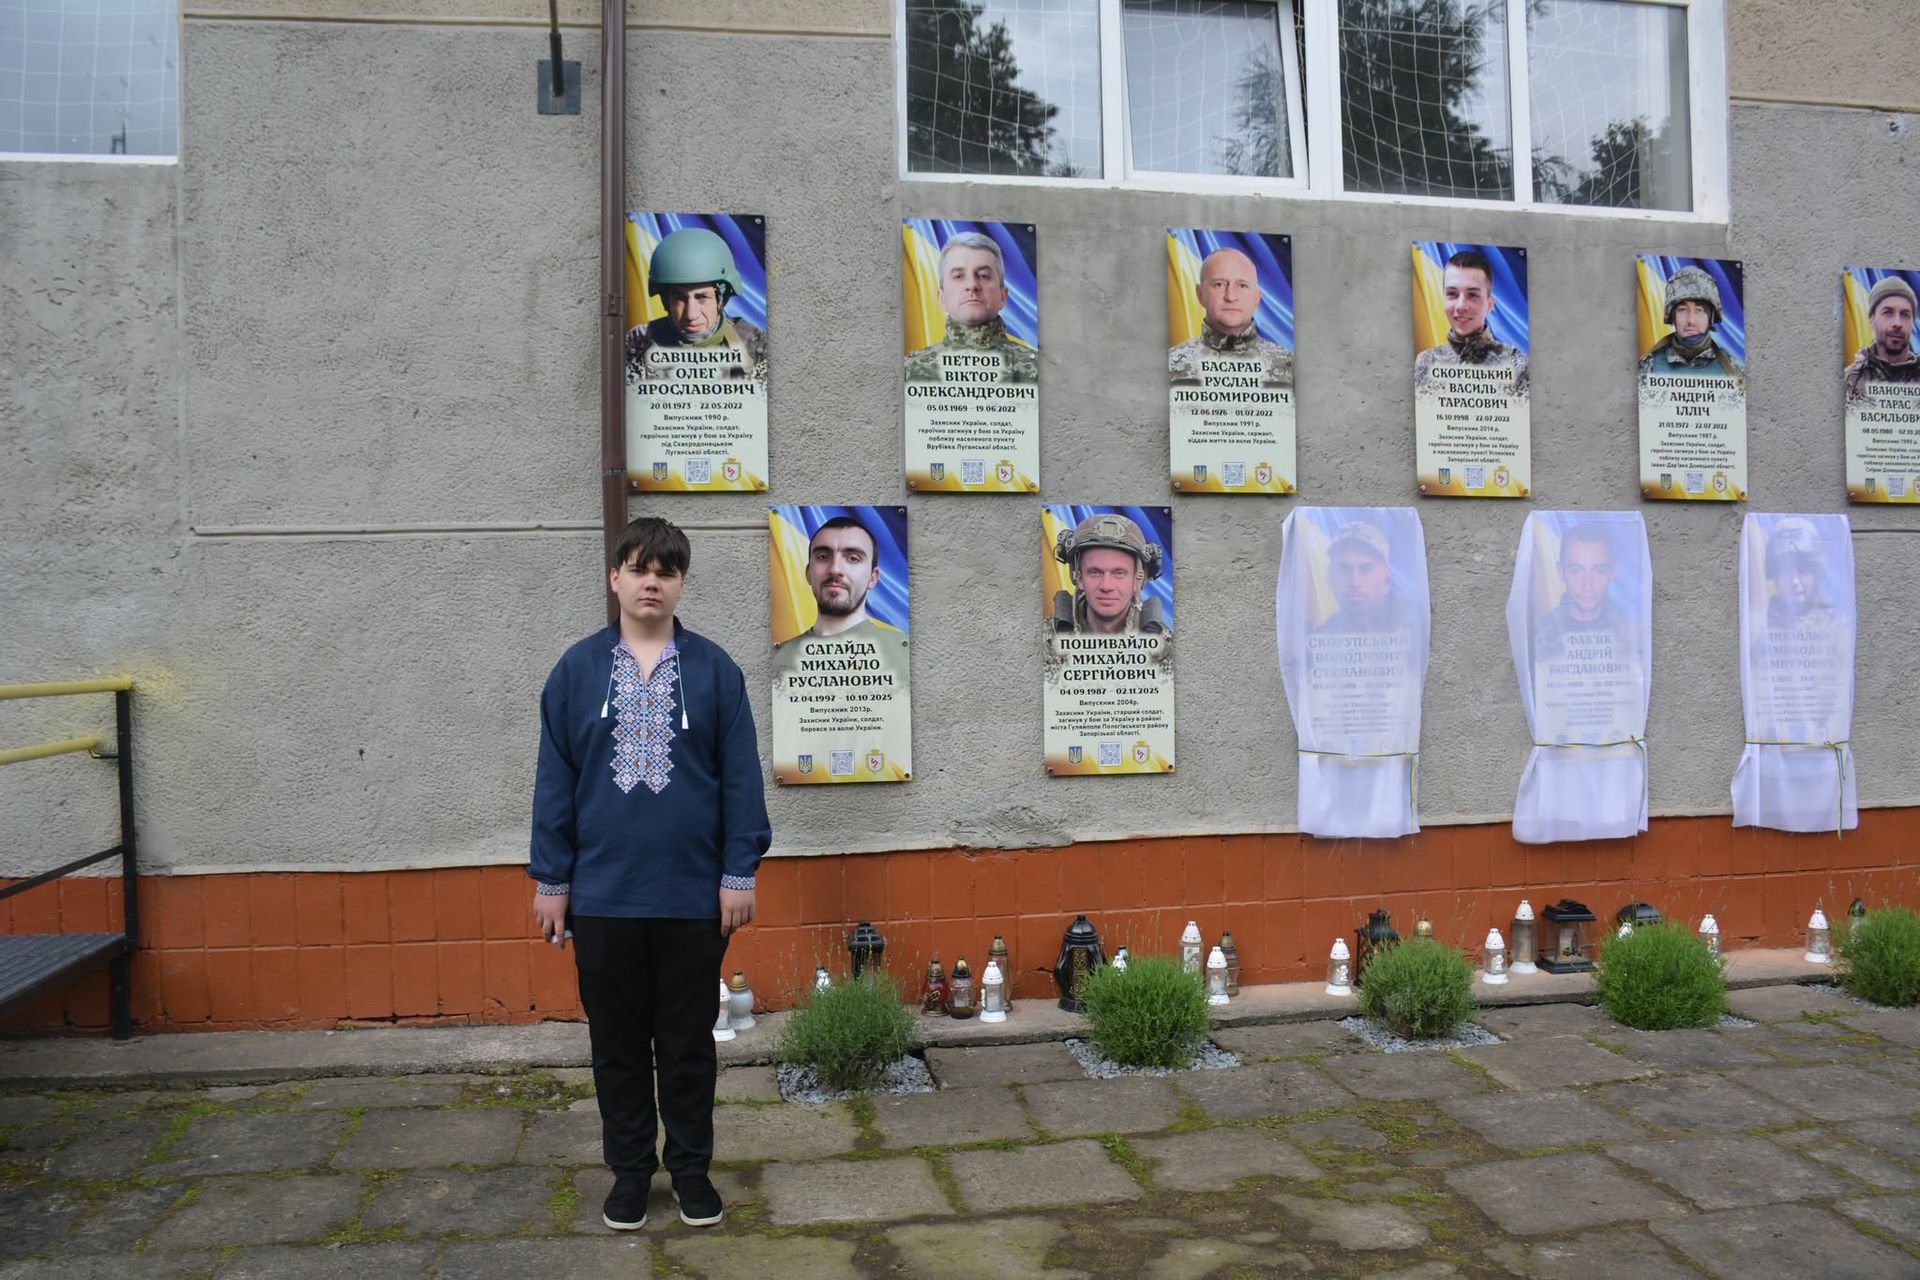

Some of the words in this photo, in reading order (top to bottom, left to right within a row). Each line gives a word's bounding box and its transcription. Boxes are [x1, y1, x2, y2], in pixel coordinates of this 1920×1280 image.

[650, 349, 742, 364] САВІЦЬКИЙ
[942, 355, 1000, 367] ПЕТРОВ
[1201, 361, 1262, 373] БАСАРАБ
[676, 368, 717, 379] ОЛЕГ
[945, 371, 998, 383] ВІКТОР
[1432, 367, 1513, 381] СКОРЕЦЬКИЙ
[1204, 376, 1259, 388] РУСЛАН
[1649, 377, 1735, 390] ВОЛОШИНЮК
[637, 384, 755, 396] ЯРОСЛАВОВИЧ
[907, 386, 1036, 400] ОЛЕКСАНДРОВИЧ
[1449, 383, 1497, 394] ВАСИЛЬ
[1868, 385, 1920, 397] ІВАНОЧКО
[1174, 391, 1289, 403] ЛЮБОМИРОВИЧ
[1669, 390, 1715, 403] АНДРІЙ
[1438, 397, 1508, 409] ТАРАСОВИЧ
[1879, 399, 1911, 410] ТАРАС
[1676, 406, 1710, 417] ІЛЛІЧ
[664, 414, 702, 422] Випускник
[1203, 420, 1238, 428] Випускник
[727, 432, 753, 440] Україну
[805, 640, 876, 656] САГАЙДА
[1060, 635, 1159, 650] ПОШИВАЙЛО
[1072, 651, 1147, 665] МИХАЙЛО
[1567, 646, 1613, 660] АНДРІЙ
[800, 656, 880, 672] МИХАЙЛО
[1063, 666, 1156, 681] СЕРГІЙОВИЧ
[788, 675, 893, 688] РУСЛАНОВИЧ
[846, 694, 893, 702] 10.10.2025
[1079, 699, 1116, 707] Випускник
[810, 707, 848, 715] Випускник
[849, 706, 873, 714] 2013р.
